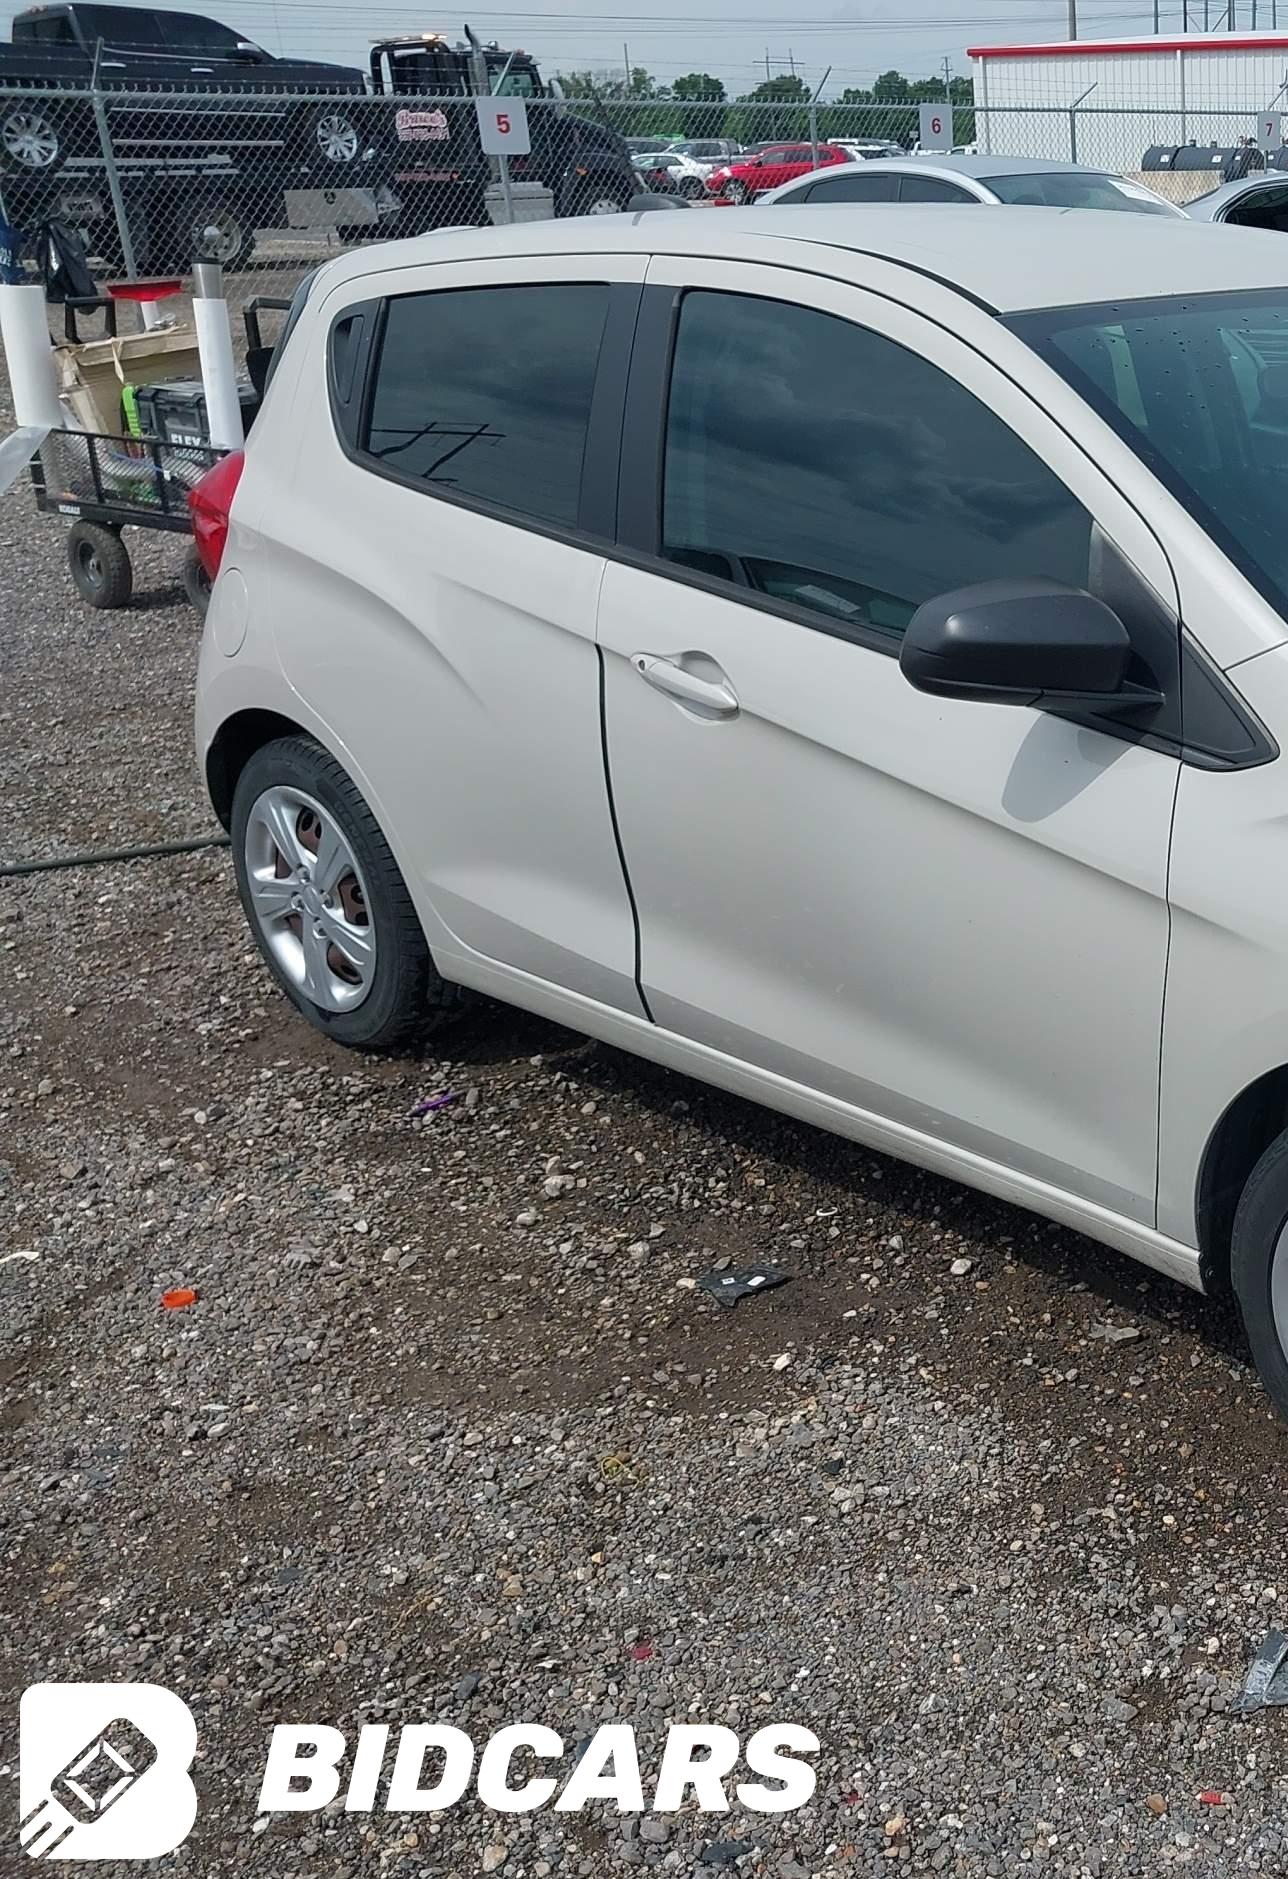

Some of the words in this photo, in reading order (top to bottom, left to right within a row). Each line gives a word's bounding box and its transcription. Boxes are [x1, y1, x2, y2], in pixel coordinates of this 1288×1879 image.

[495, 114, 511, 134] 5
[931, 117, 941, 134] 6
[1265, 122, 1273, 137] 7
